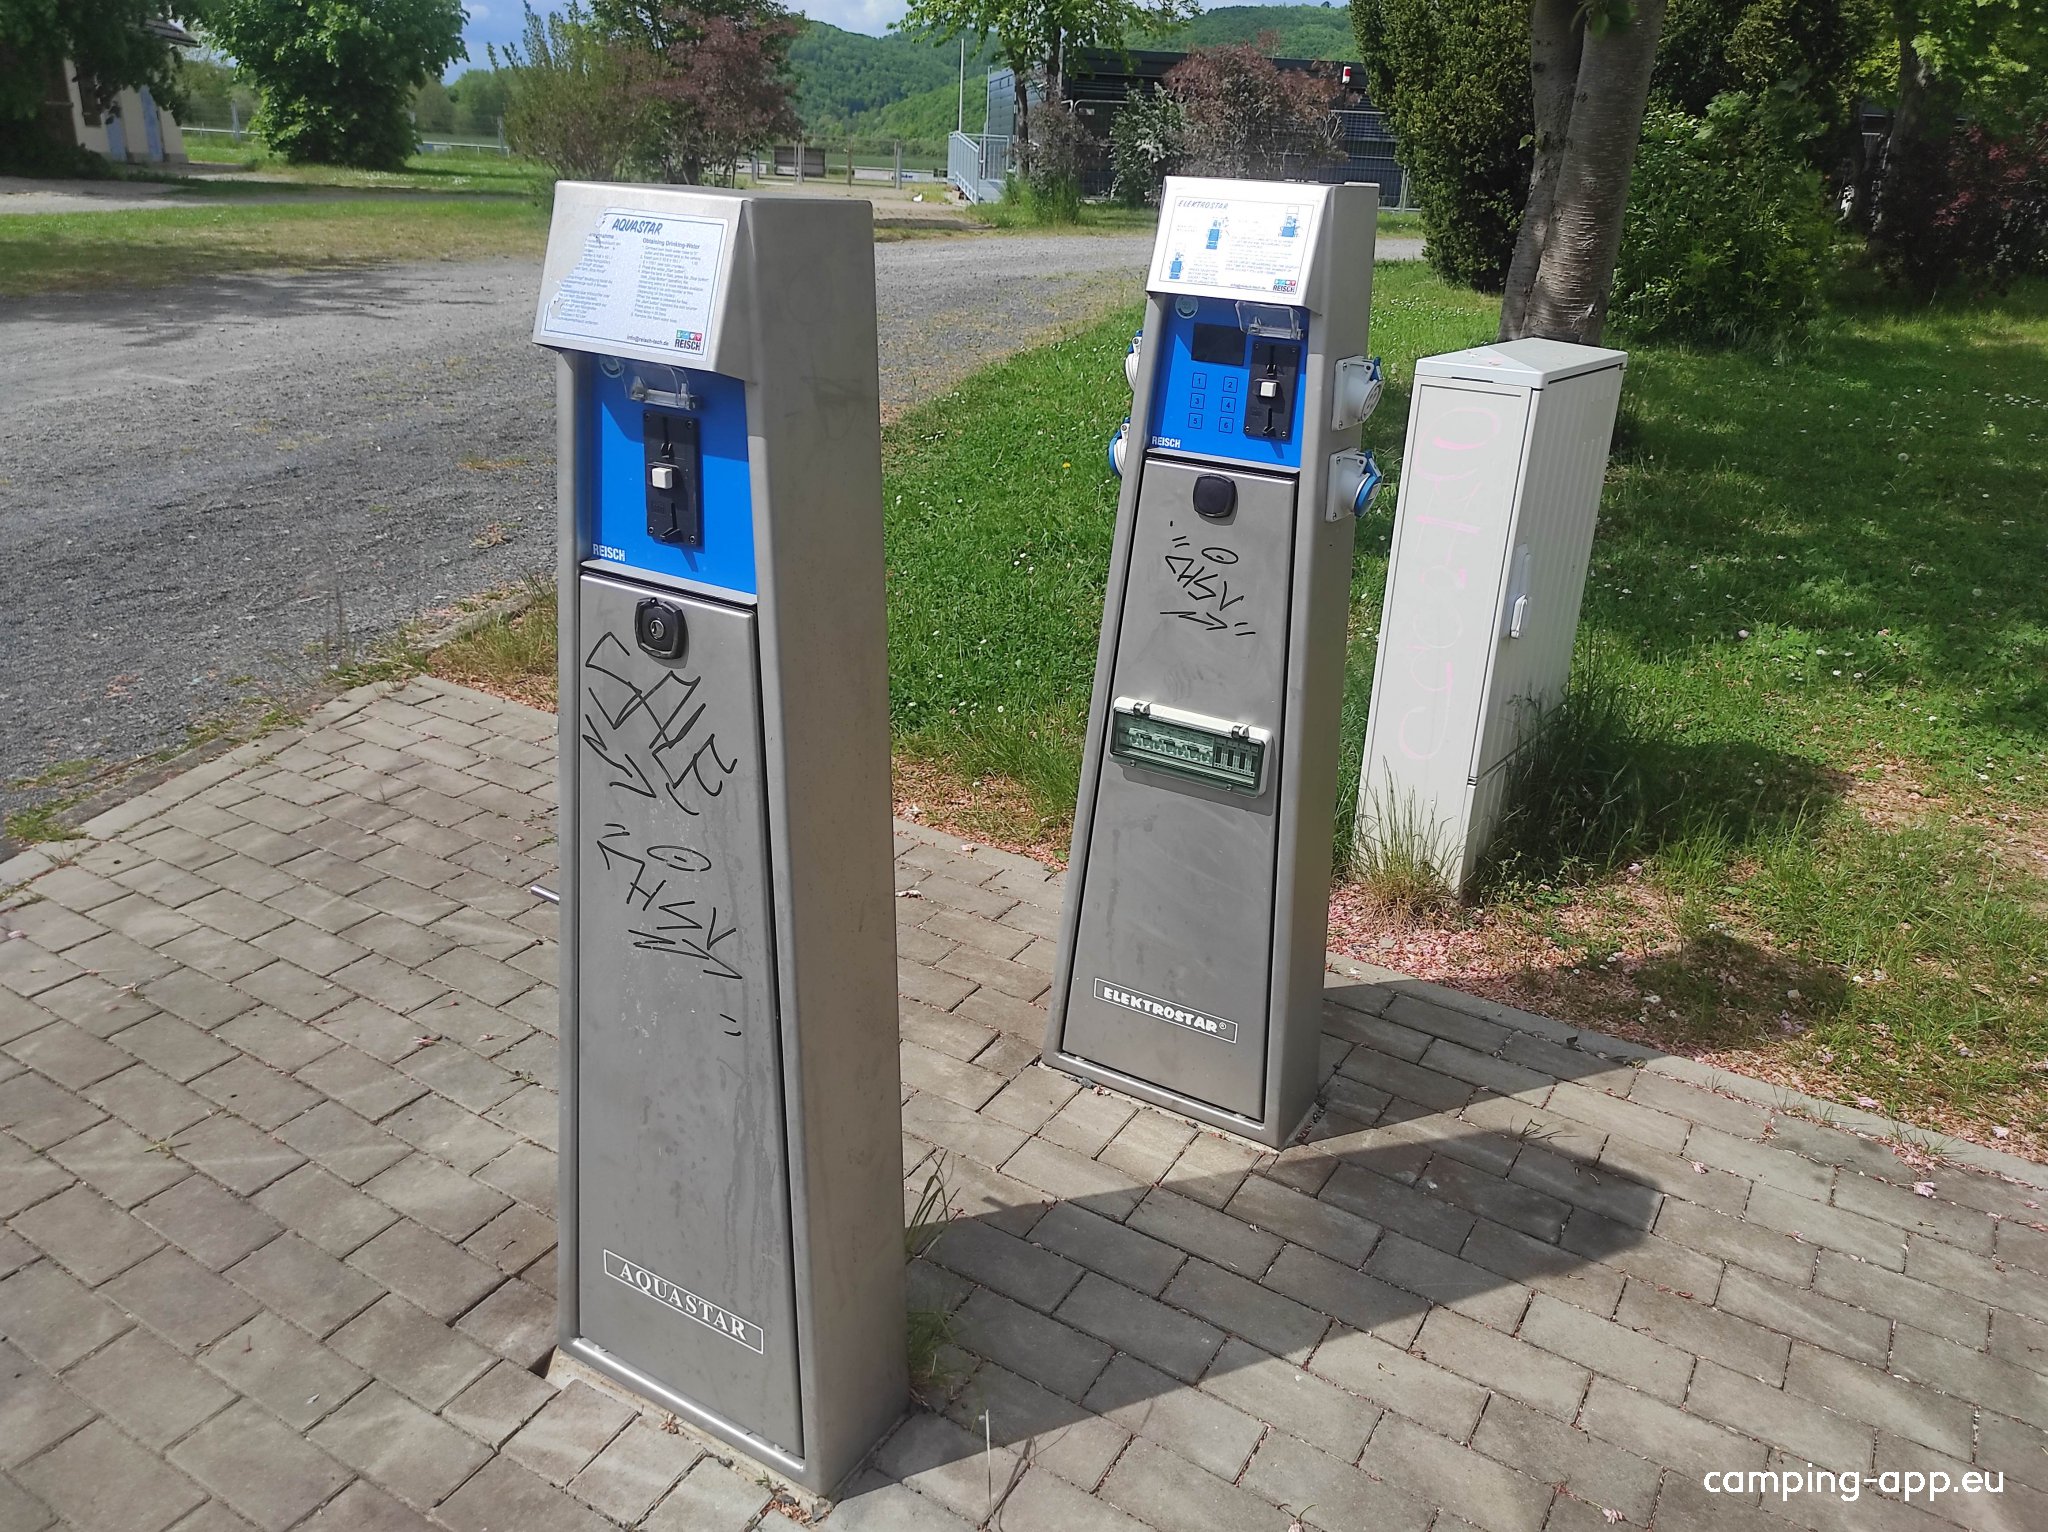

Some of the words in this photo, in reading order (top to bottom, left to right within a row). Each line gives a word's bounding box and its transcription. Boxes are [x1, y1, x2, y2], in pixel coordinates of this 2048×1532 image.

[1178, 199, 1229, 209] ELEKTROSTAR
[612, 218, 663, 234] AQUASTAR
[643, 238, 664, 246] Obtaining
[1272, 284, 1295, 293] REISCH
[674, 338, 701, 351] REISCH
[1151, 435, 1181, 449] REISCH
[592, 543, 626, 562] REISCH
[619, 1262, 747, 1341] AQUASTAR
